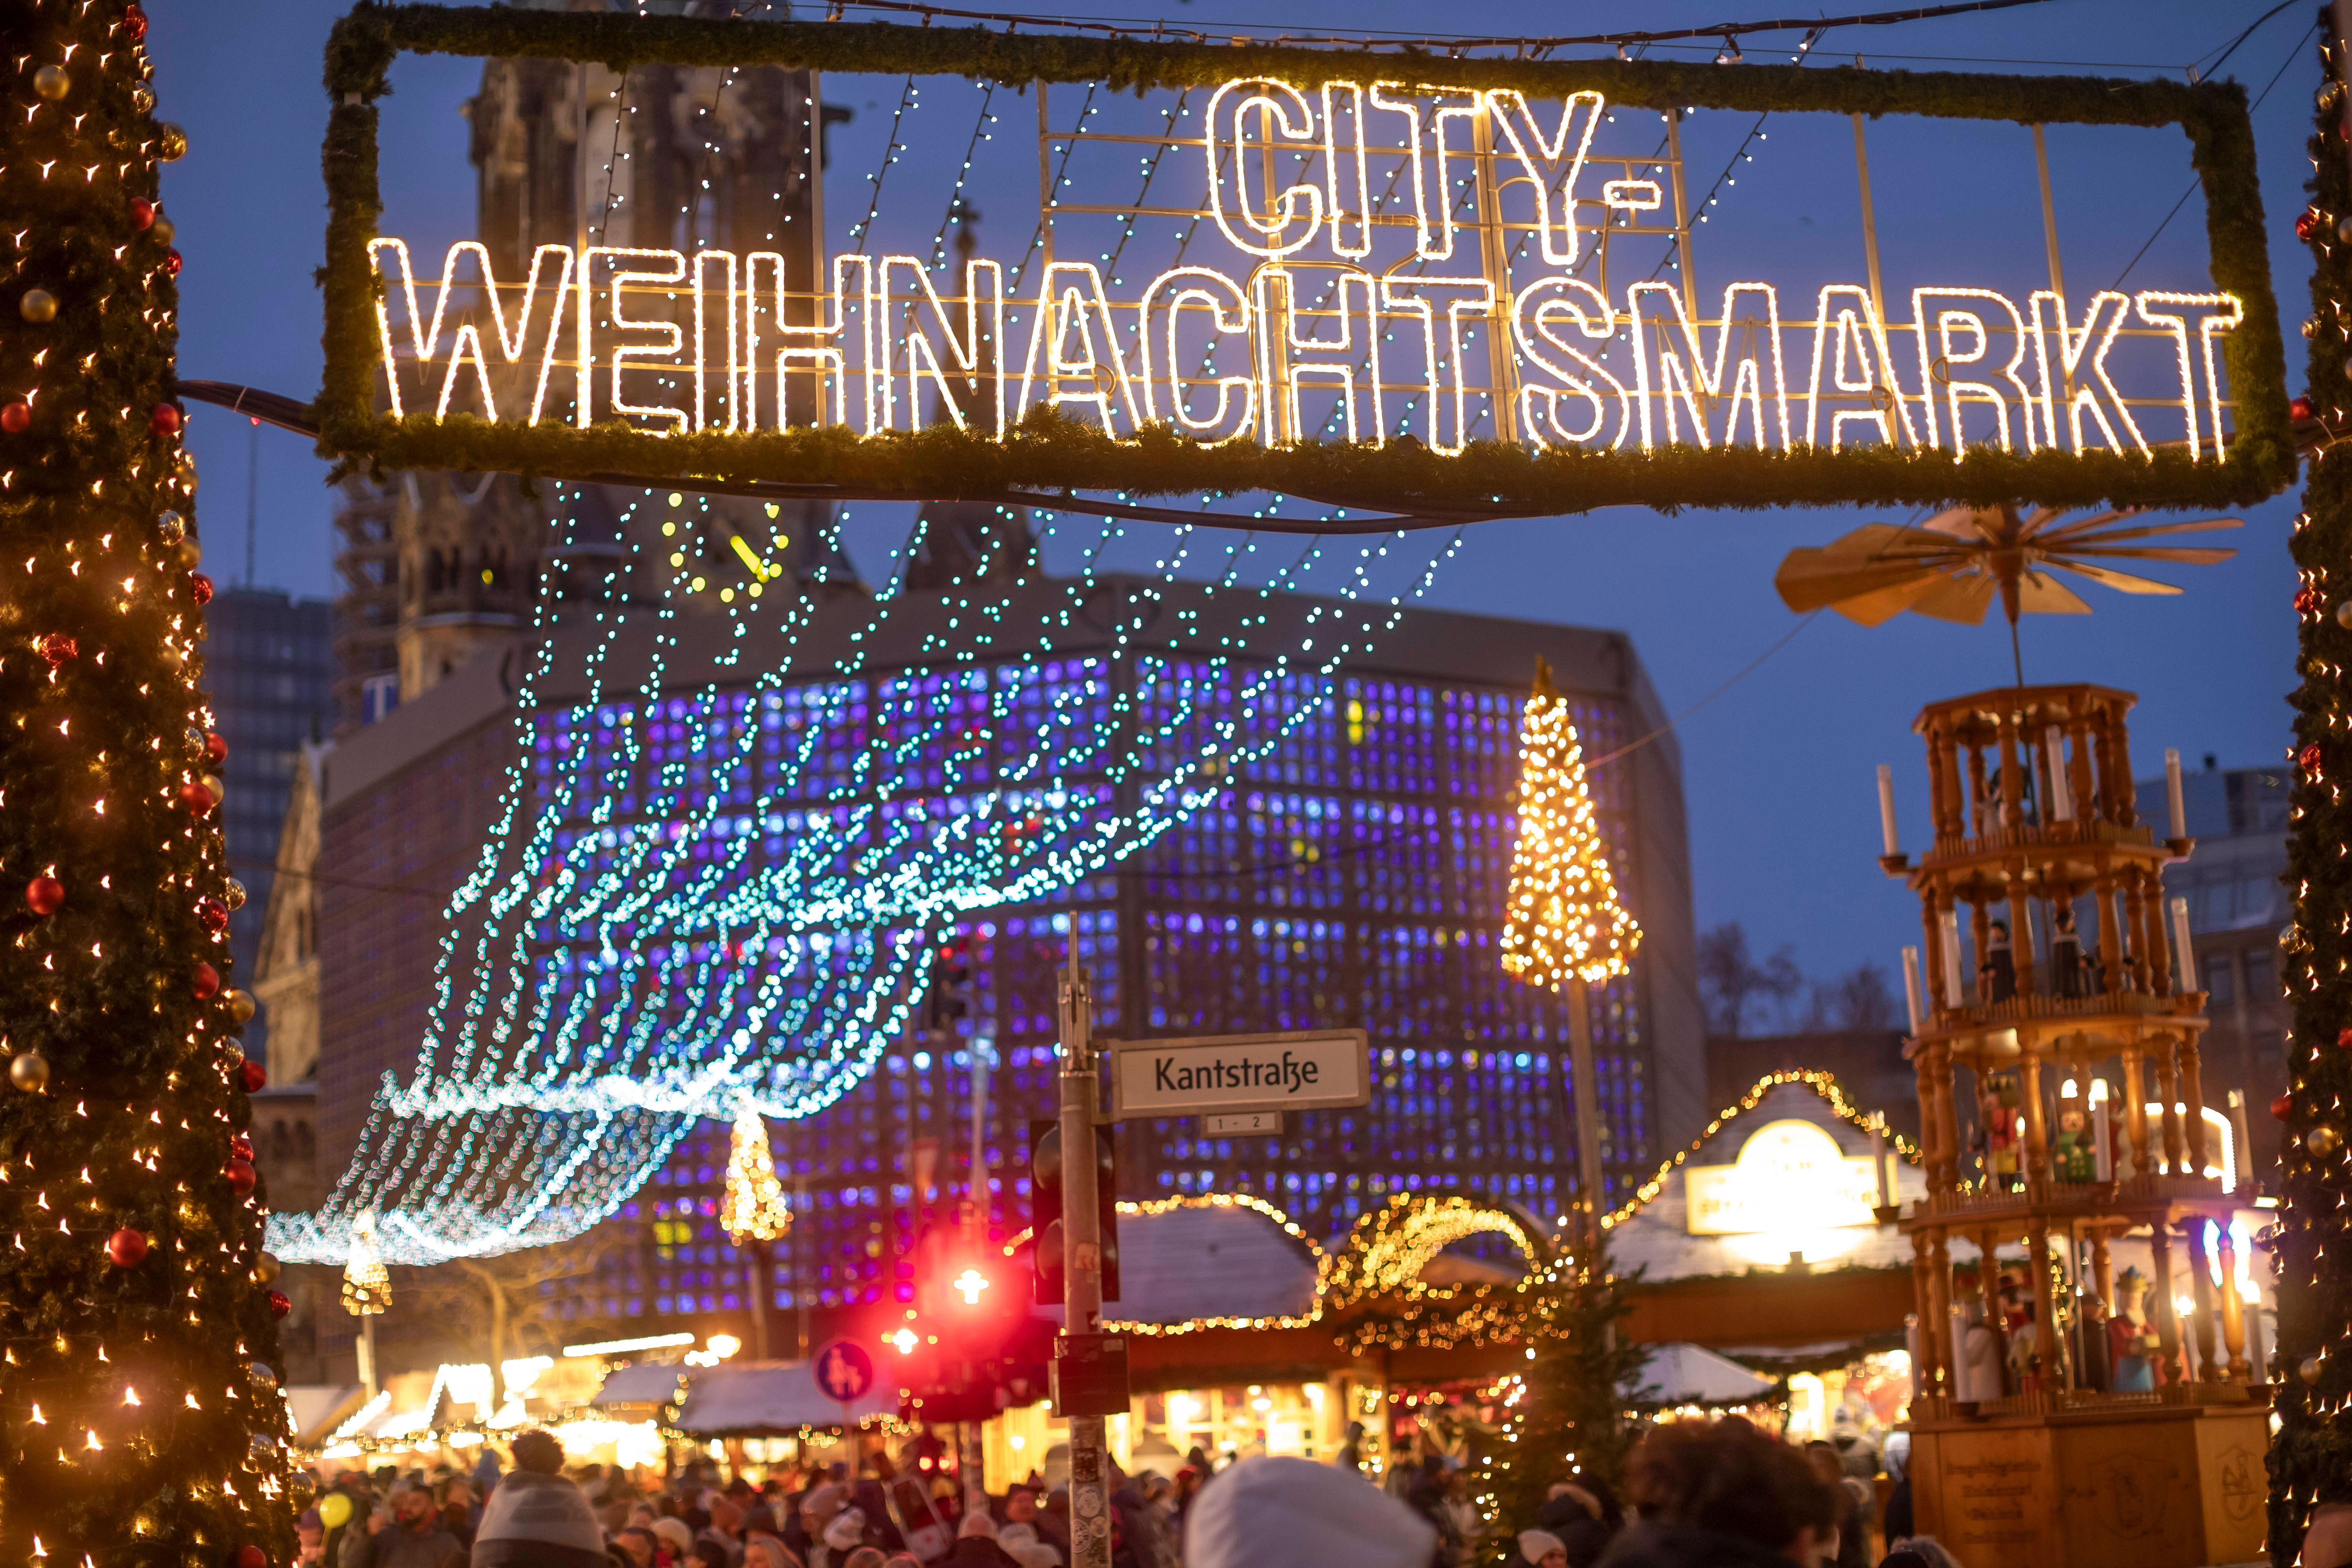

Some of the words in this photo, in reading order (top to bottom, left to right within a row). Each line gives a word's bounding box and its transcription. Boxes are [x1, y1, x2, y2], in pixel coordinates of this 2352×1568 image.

[1206, 76, 1662, 265] CITY-
[367, 238, 2244, 464] WEIHNACHTSMARKT
[1155, 1051, 1319, 1093] Kantstraße
[1253, 1116, 1260, 1128] 2
